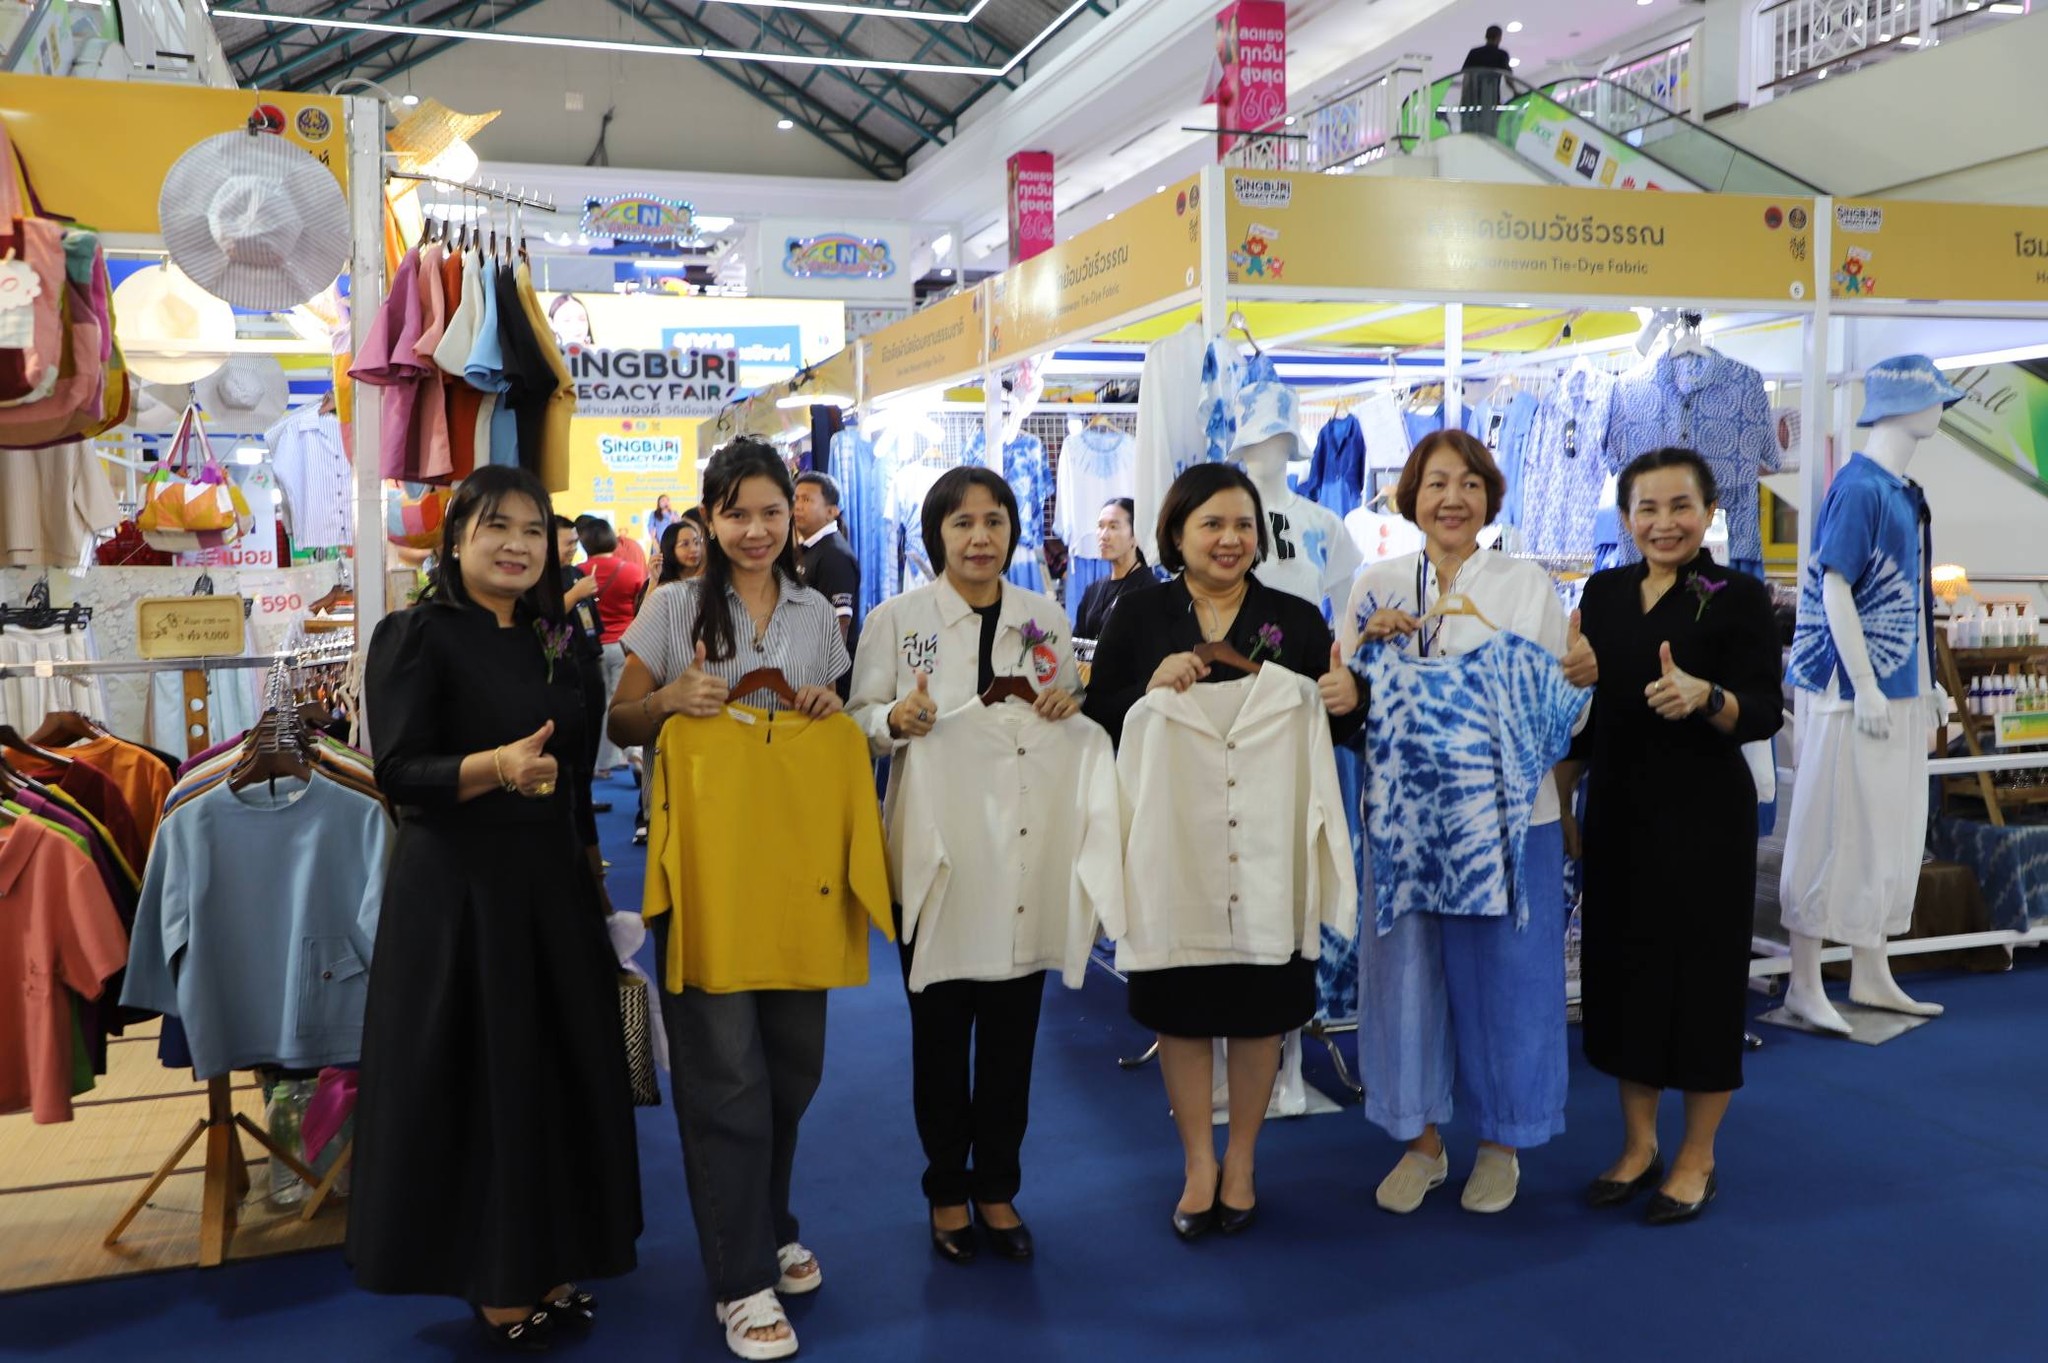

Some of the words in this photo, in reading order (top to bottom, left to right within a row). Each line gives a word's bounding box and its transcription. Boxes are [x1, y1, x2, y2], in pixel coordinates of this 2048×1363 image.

[1608, 258, 1648, 275] Fabric
[577, 384, 662, 400] EGACY
[261, 593, 302, 614] 590
